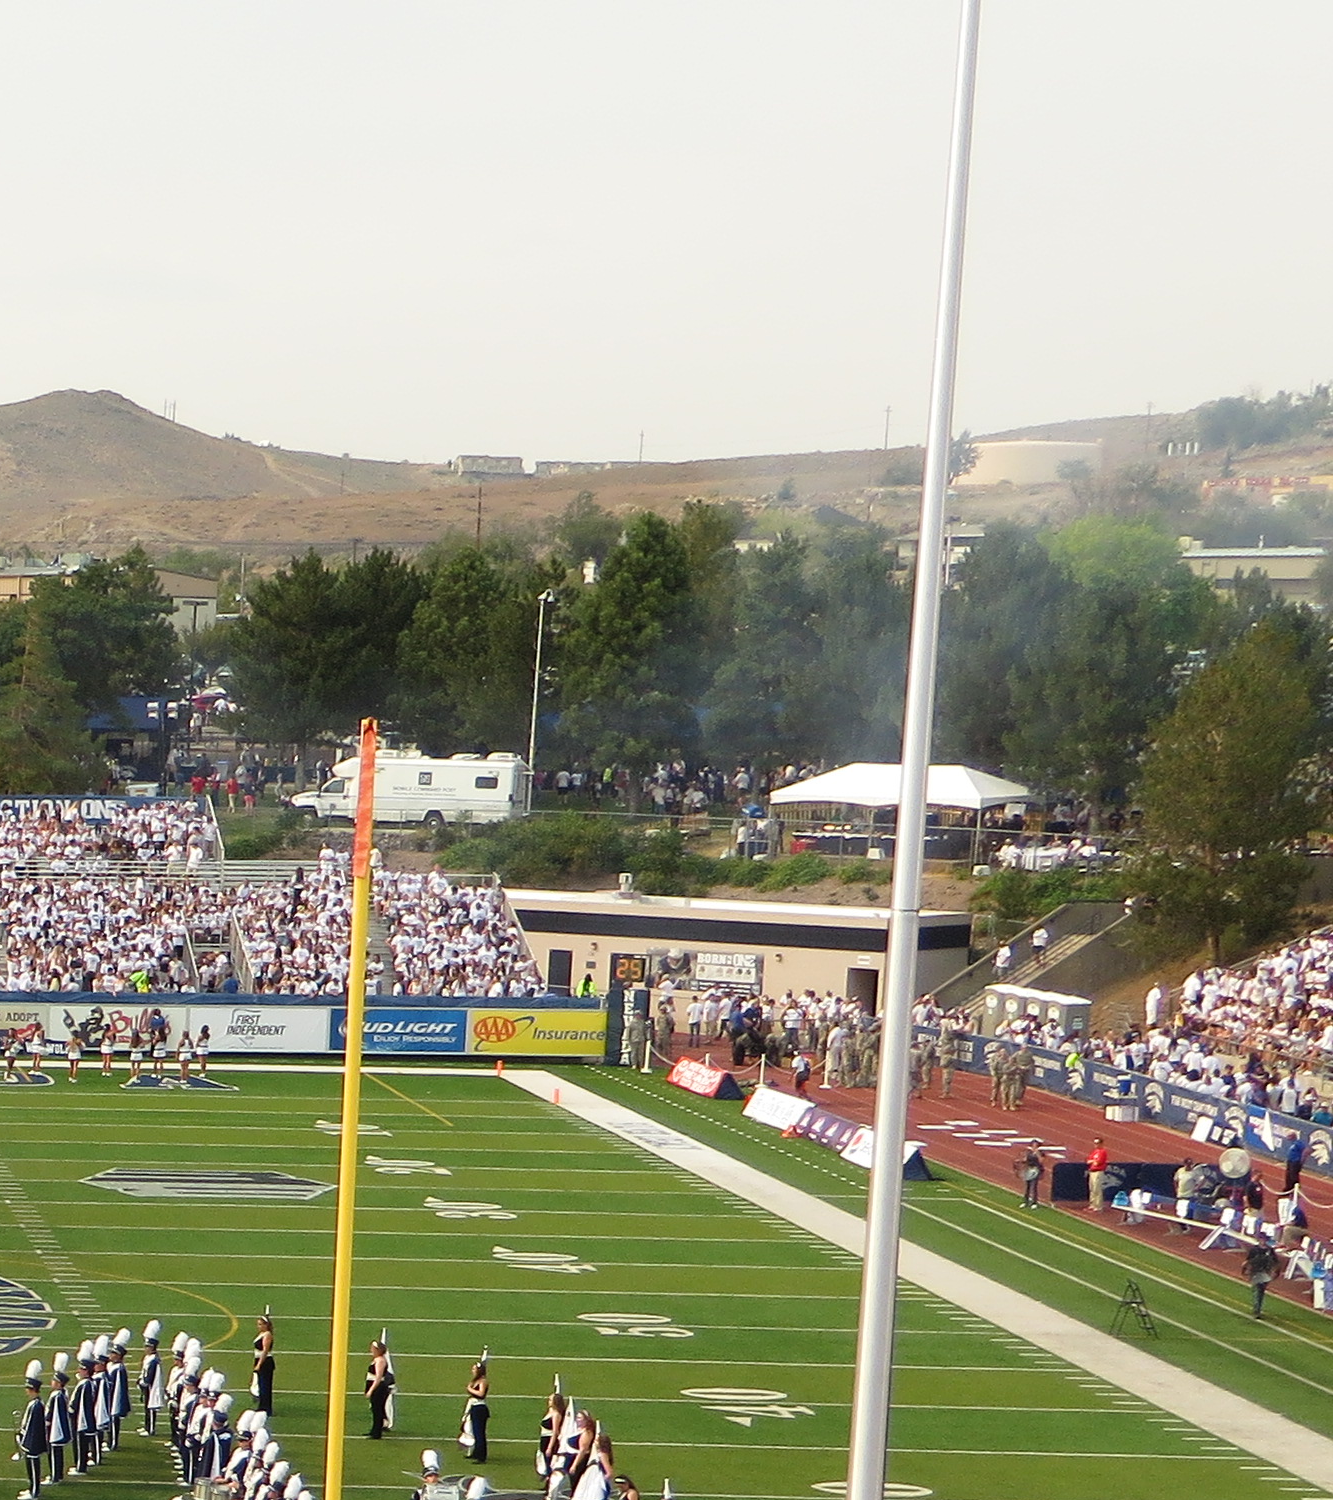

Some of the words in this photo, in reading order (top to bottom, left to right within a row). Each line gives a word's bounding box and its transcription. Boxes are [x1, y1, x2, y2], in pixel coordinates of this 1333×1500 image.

[697, 953, 723, 964] BORN
[733, 954, 757, 967] ONE
[617, 958, 642, 978] 25
[6, 1011, 40, 1023] ADOPT
[235, 1015, 261, 1024] FIRST
[226, 1025, 286, 1035] INDEPENDENT
[393, 1021, 458, 1034] LIGHT
[475, 1018, 516, 1041] AAA
[533, 1027, 606, 1041] Insurance
